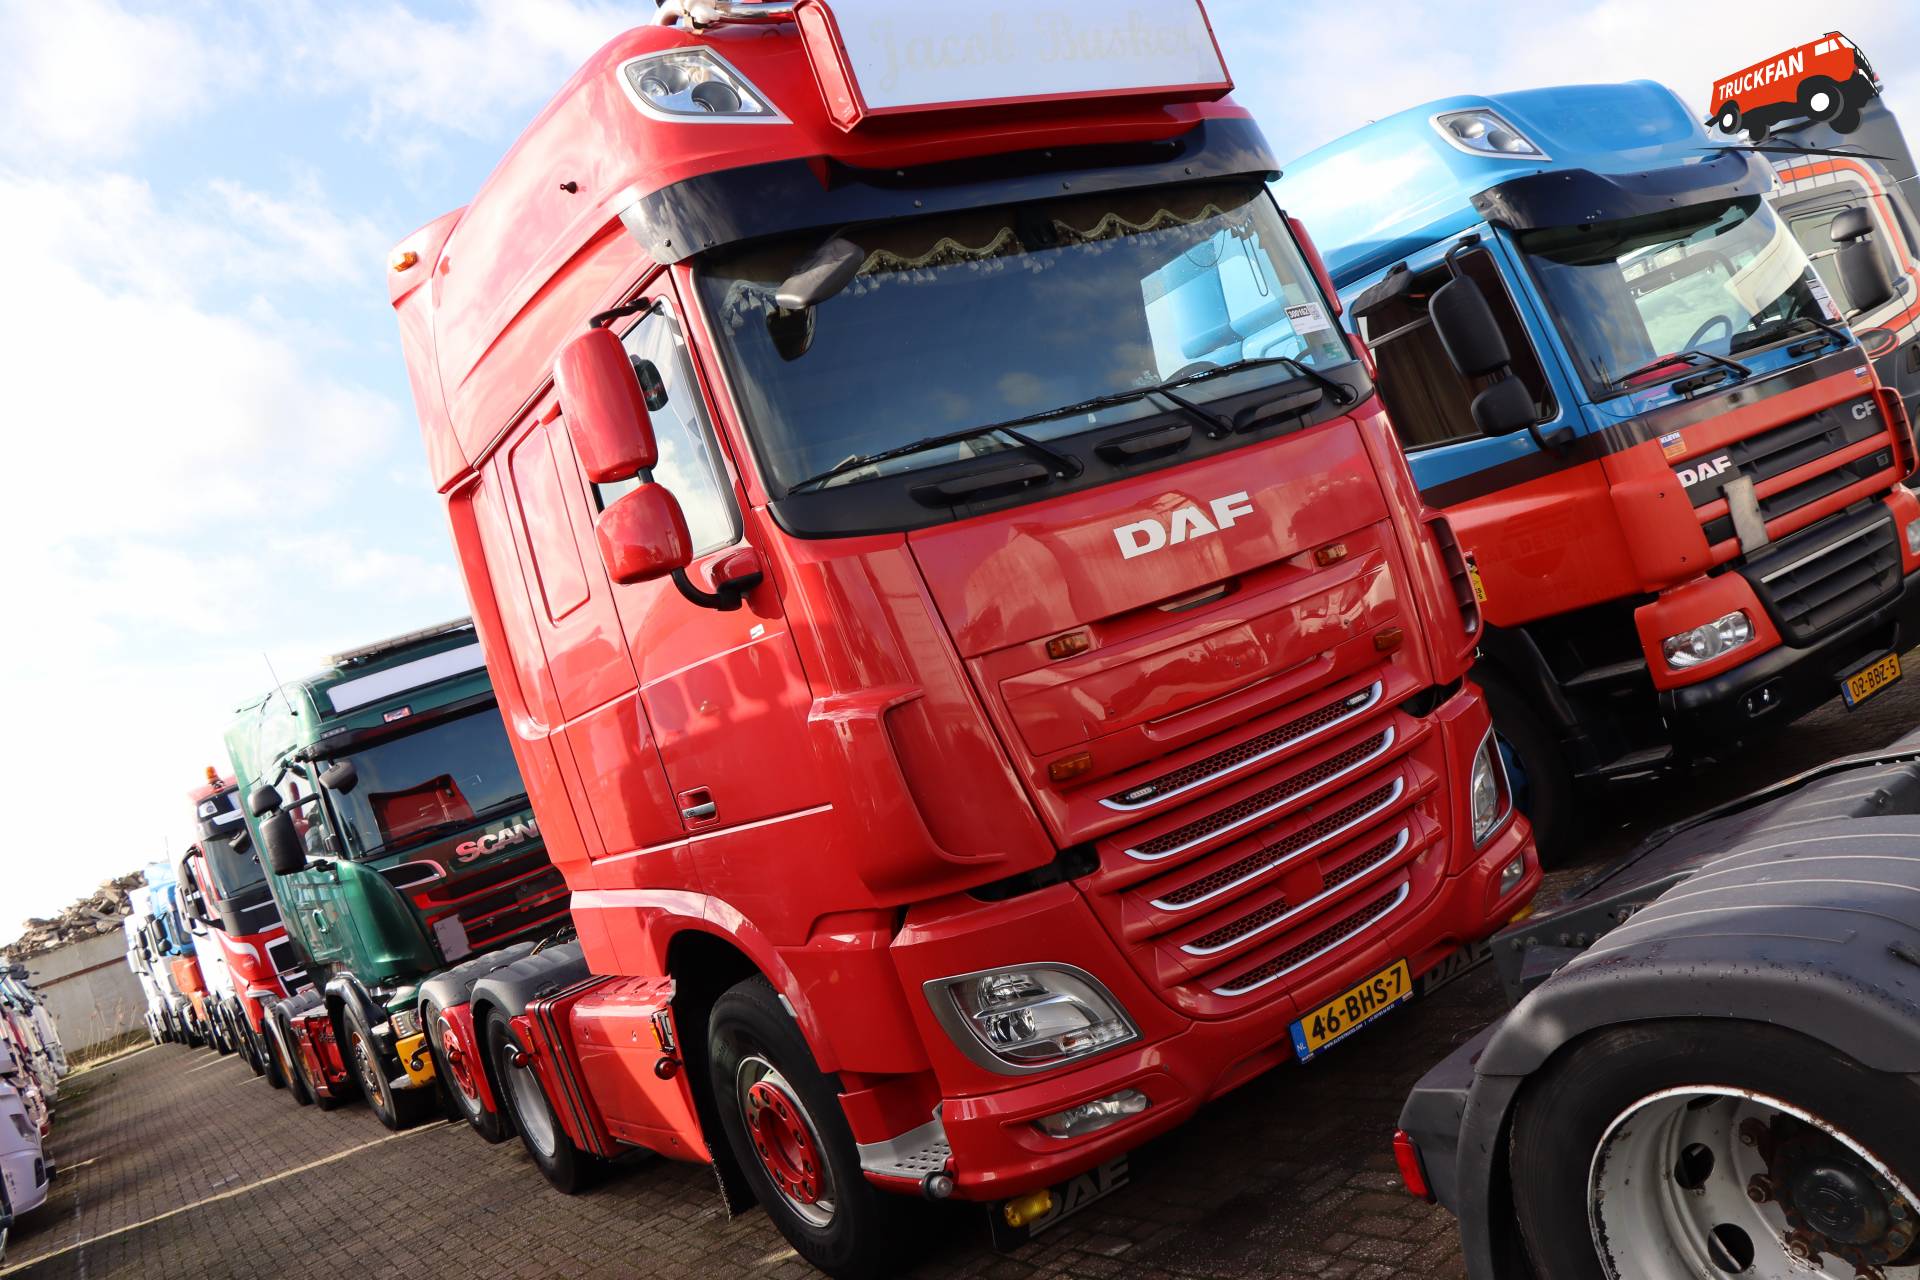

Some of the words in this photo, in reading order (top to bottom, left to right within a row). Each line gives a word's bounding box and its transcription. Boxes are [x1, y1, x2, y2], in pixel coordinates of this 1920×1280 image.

[1851, 400, 1876, 420] CF
[1676, 455, 1732, 488] DAF
[1113, 490, 1254, 560] DAF
[1312, 965, 1402, 1041] 46-BHS-7
